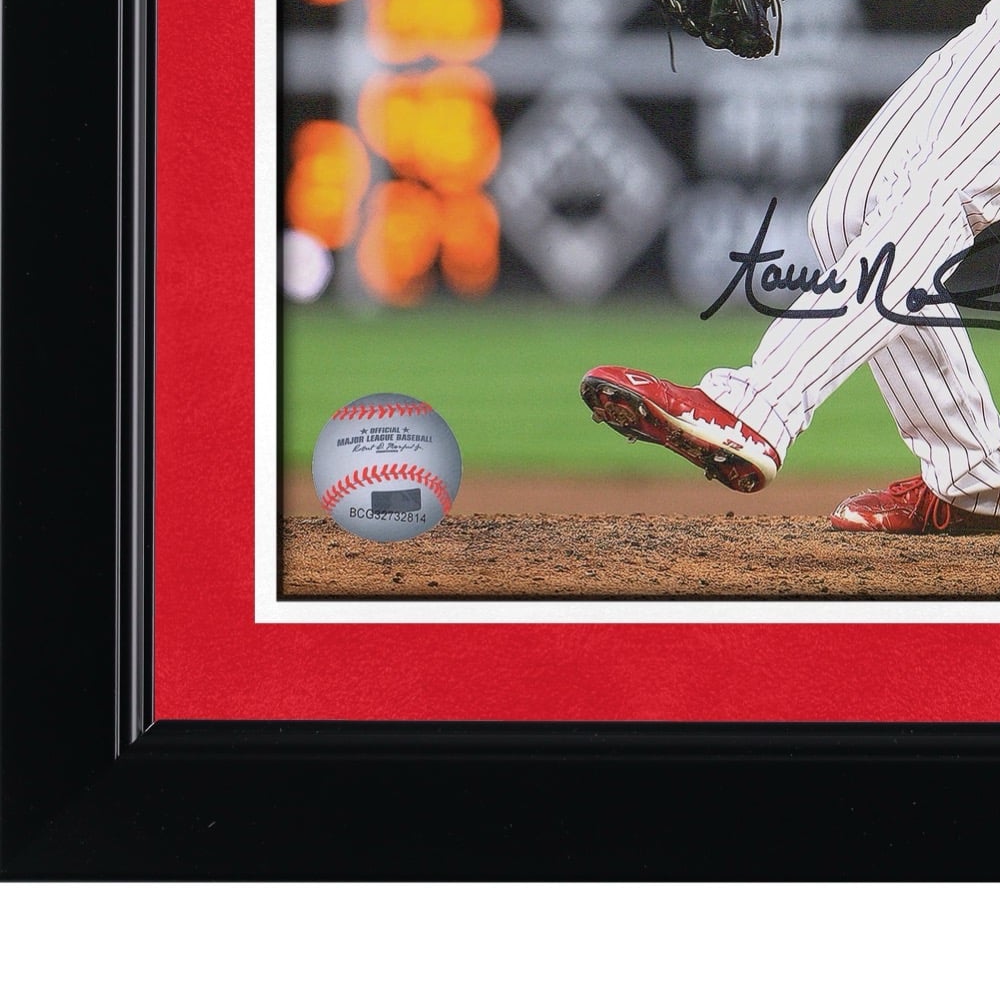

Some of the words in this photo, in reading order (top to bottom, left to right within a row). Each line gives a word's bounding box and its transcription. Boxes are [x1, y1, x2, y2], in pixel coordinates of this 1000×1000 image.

[369, 426, 400, 434] OFFICIAL
[337, 435, 364, 447] MAJOR
[366, 433, 394, 443] LEAGUE
[396, 433, 432, 443] BASEBALL
[349, 506, 427, 524] BCG32732814
